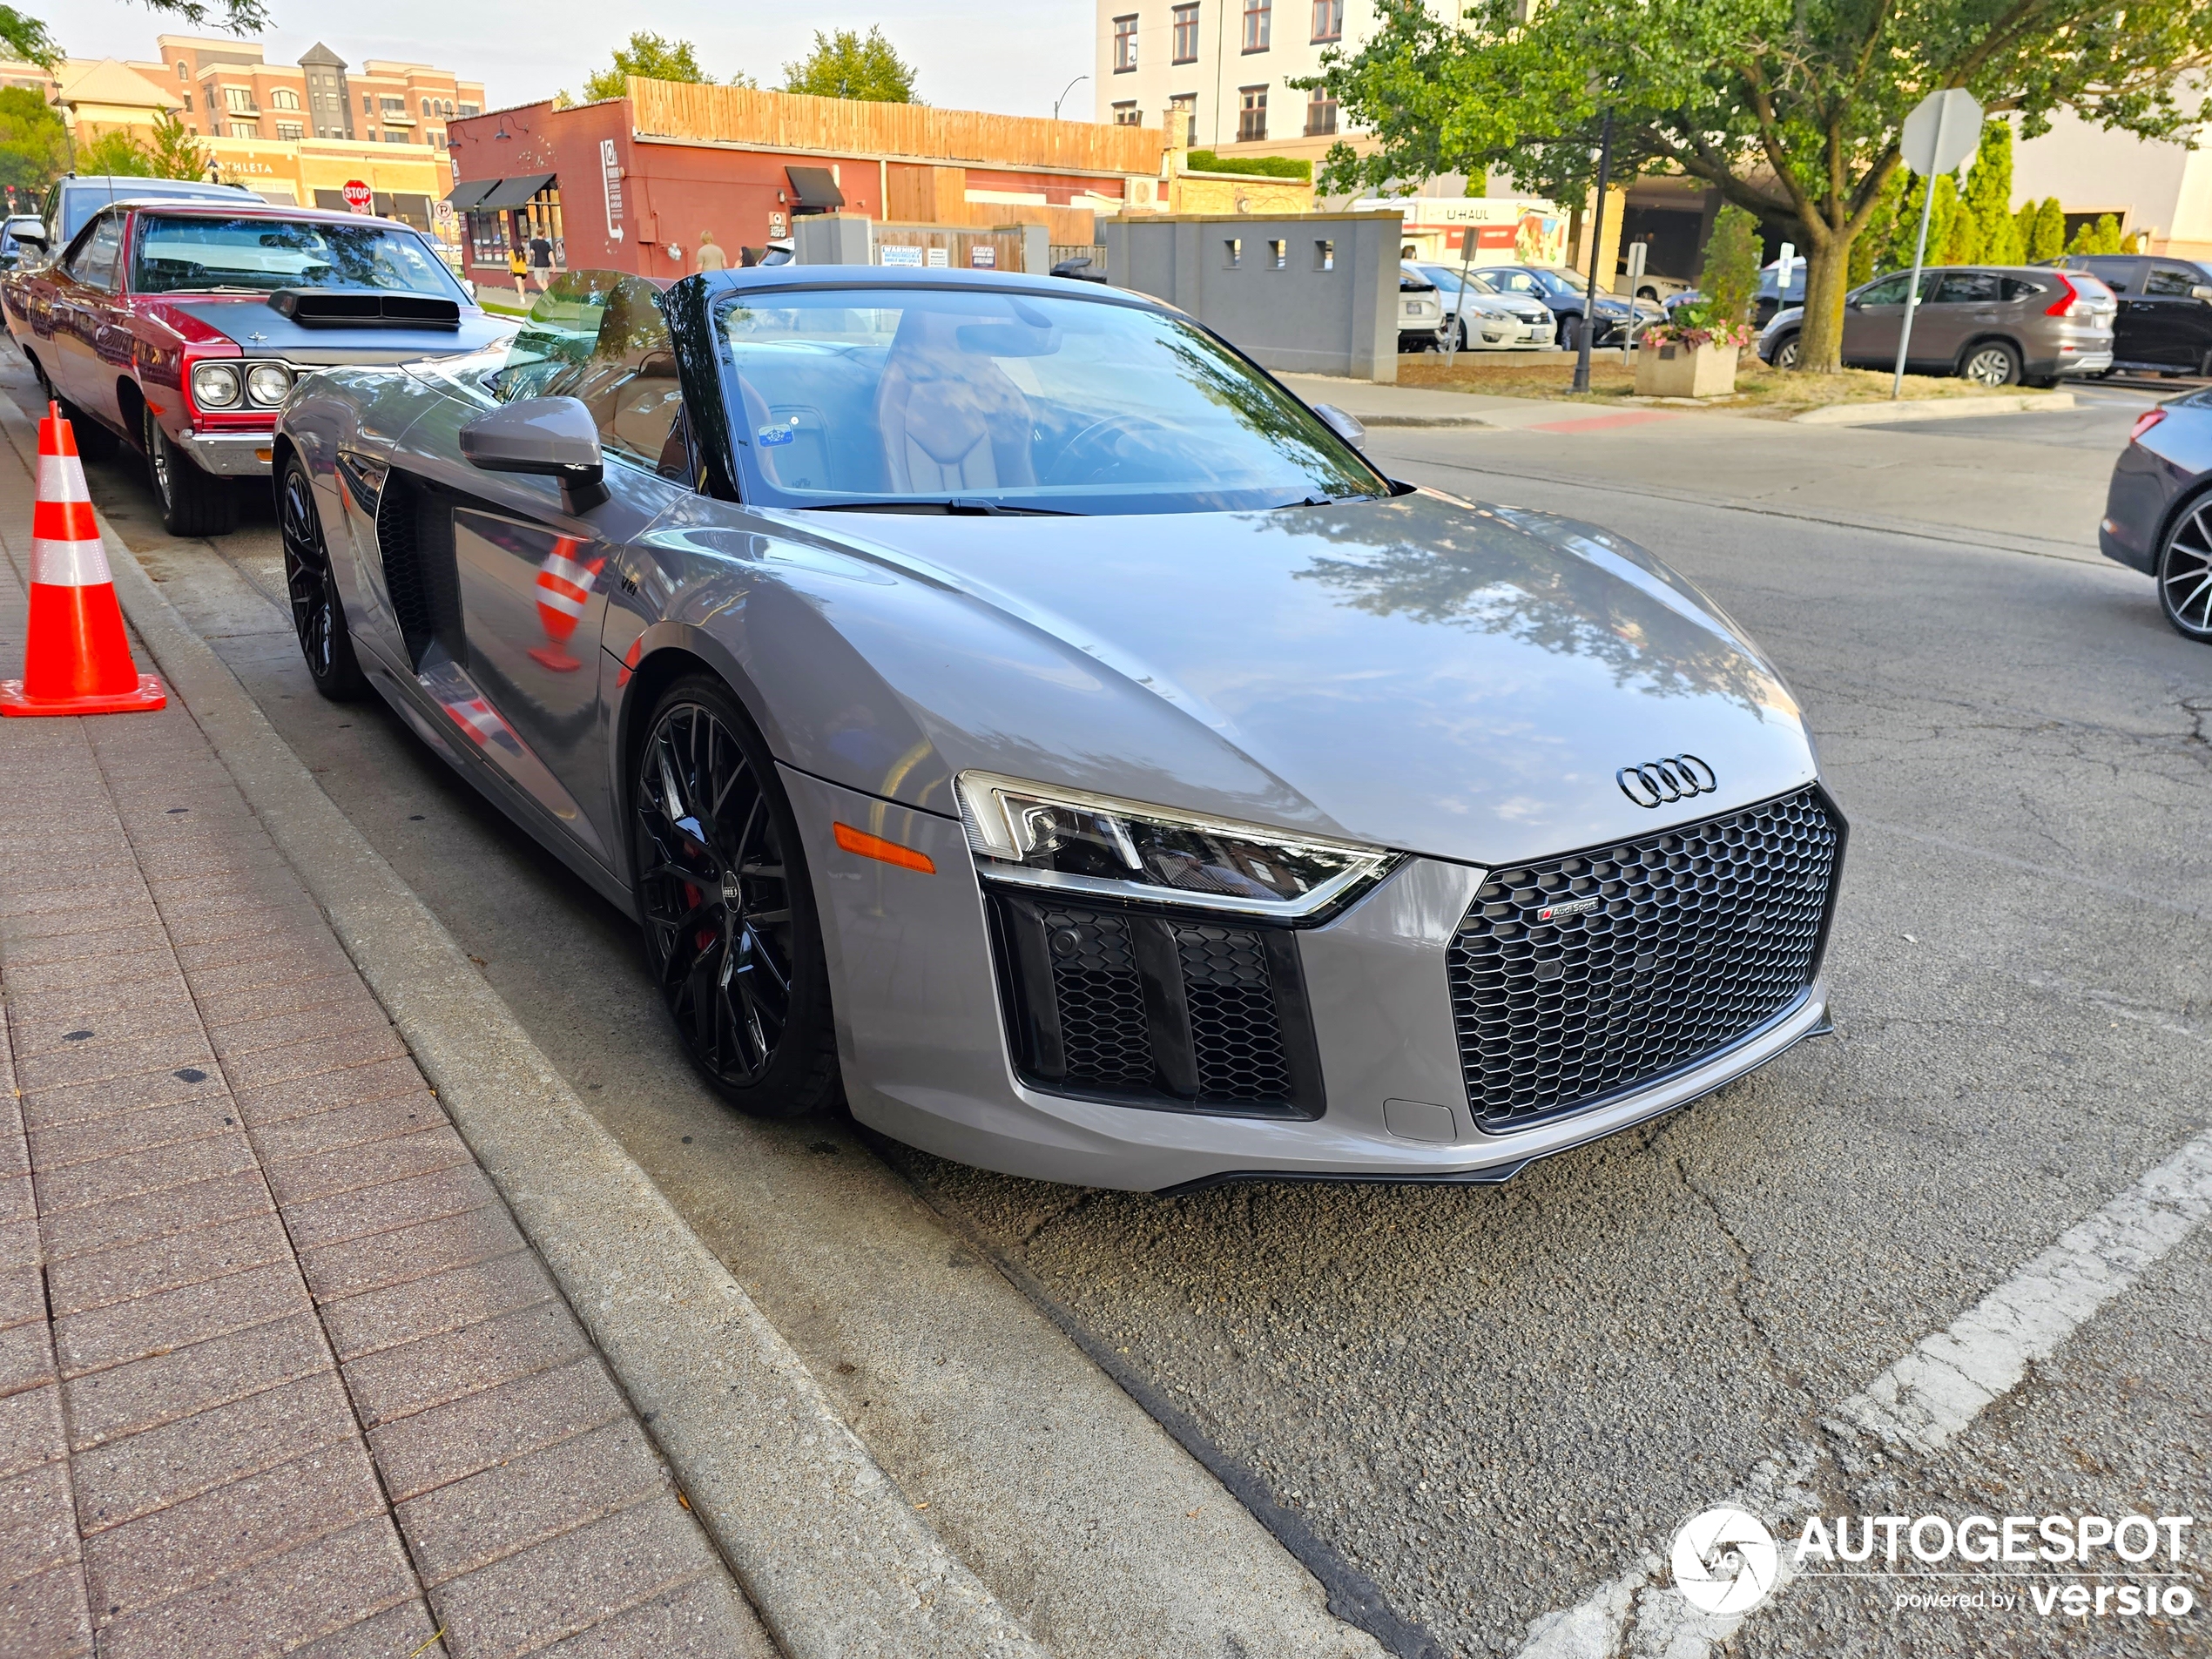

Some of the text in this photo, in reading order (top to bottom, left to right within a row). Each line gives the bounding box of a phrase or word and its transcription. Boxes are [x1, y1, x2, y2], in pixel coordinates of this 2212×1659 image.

[218, 161, 273, 173] ATHLETA
[345, 187, 369, 199] STOP
[884, 246, 921, 254] WARNING
[1554, 900, 1597, 916] Audi Sport
